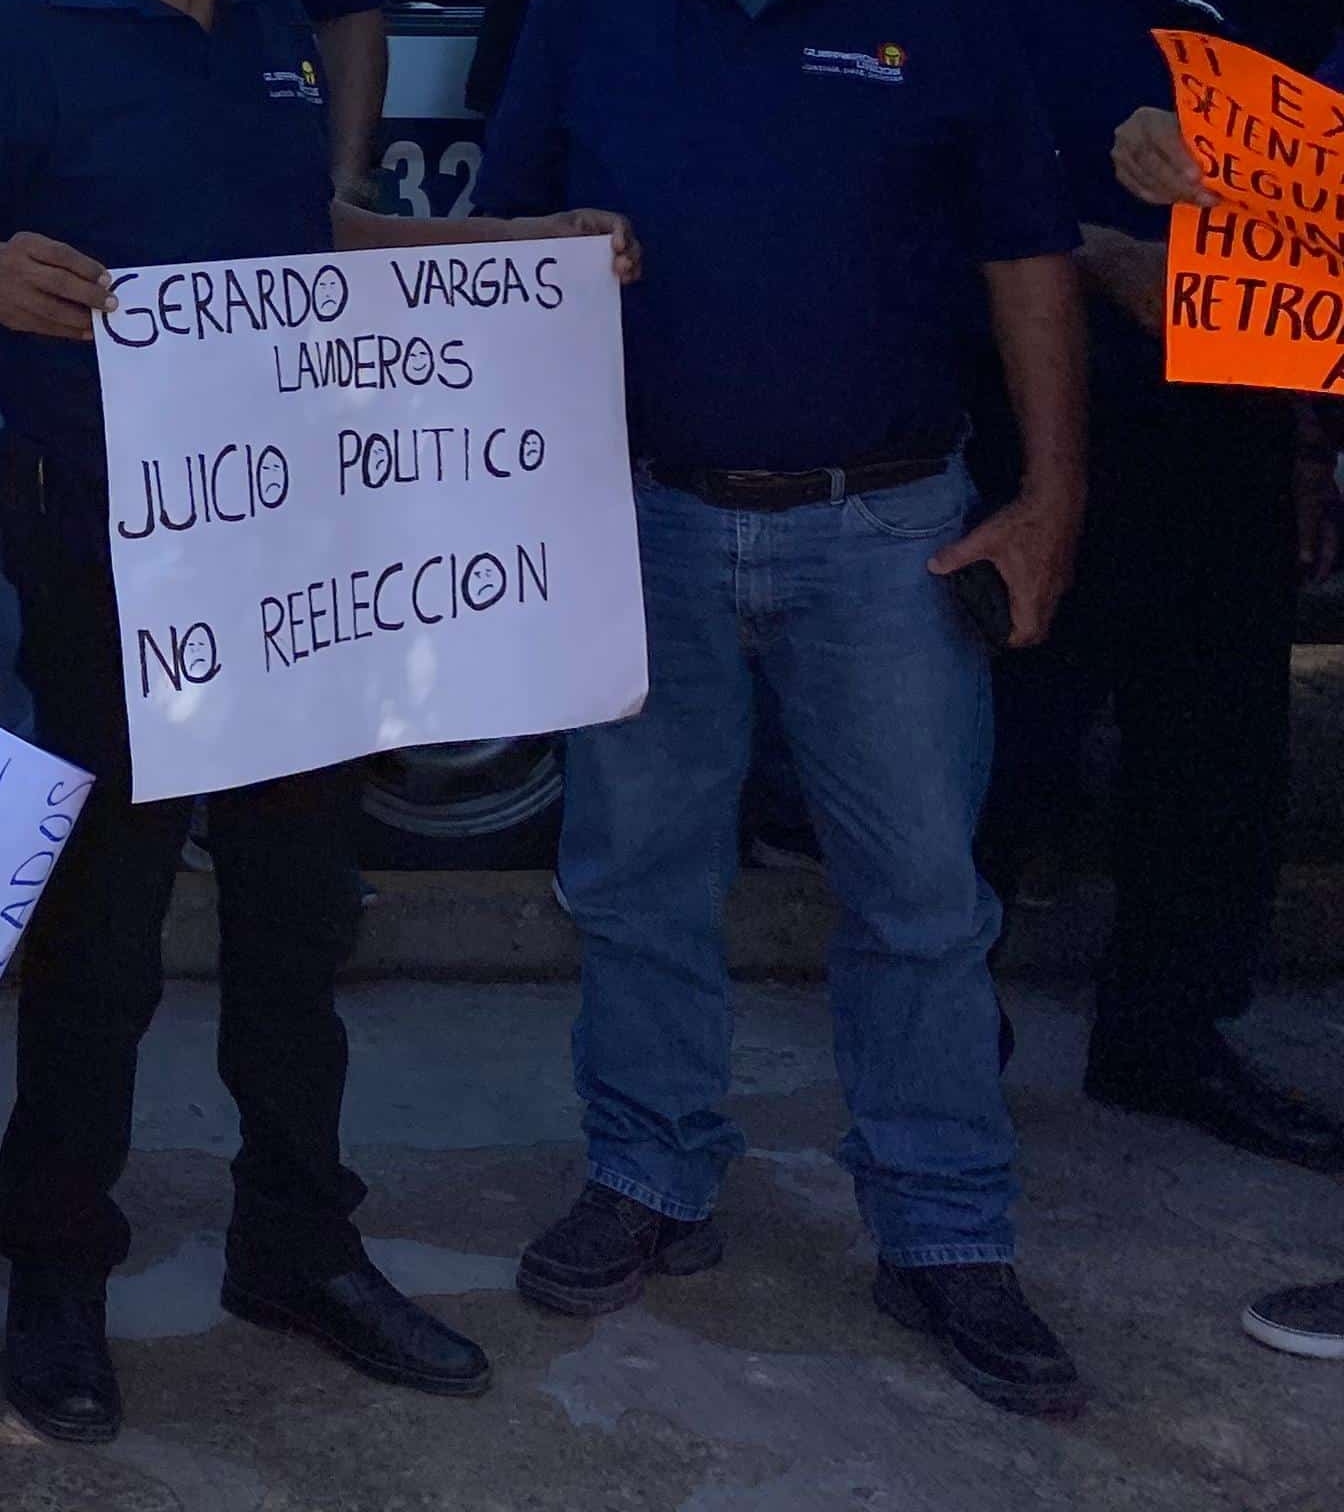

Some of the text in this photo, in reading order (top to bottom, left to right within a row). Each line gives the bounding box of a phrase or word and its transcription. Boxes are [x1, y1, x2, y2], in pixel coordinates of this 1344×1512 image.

[1181, 71, 1344, 180] SETENT
[381, 140, 478, 220] 32
[102, 256, 564, 348] GERARDO VARGAS
[273, 334, 474, 394] LANDEROS
[117, 427, 546, 540] JUICIO POLITICO
[137, 541, 550, 699] NO REELECCION
